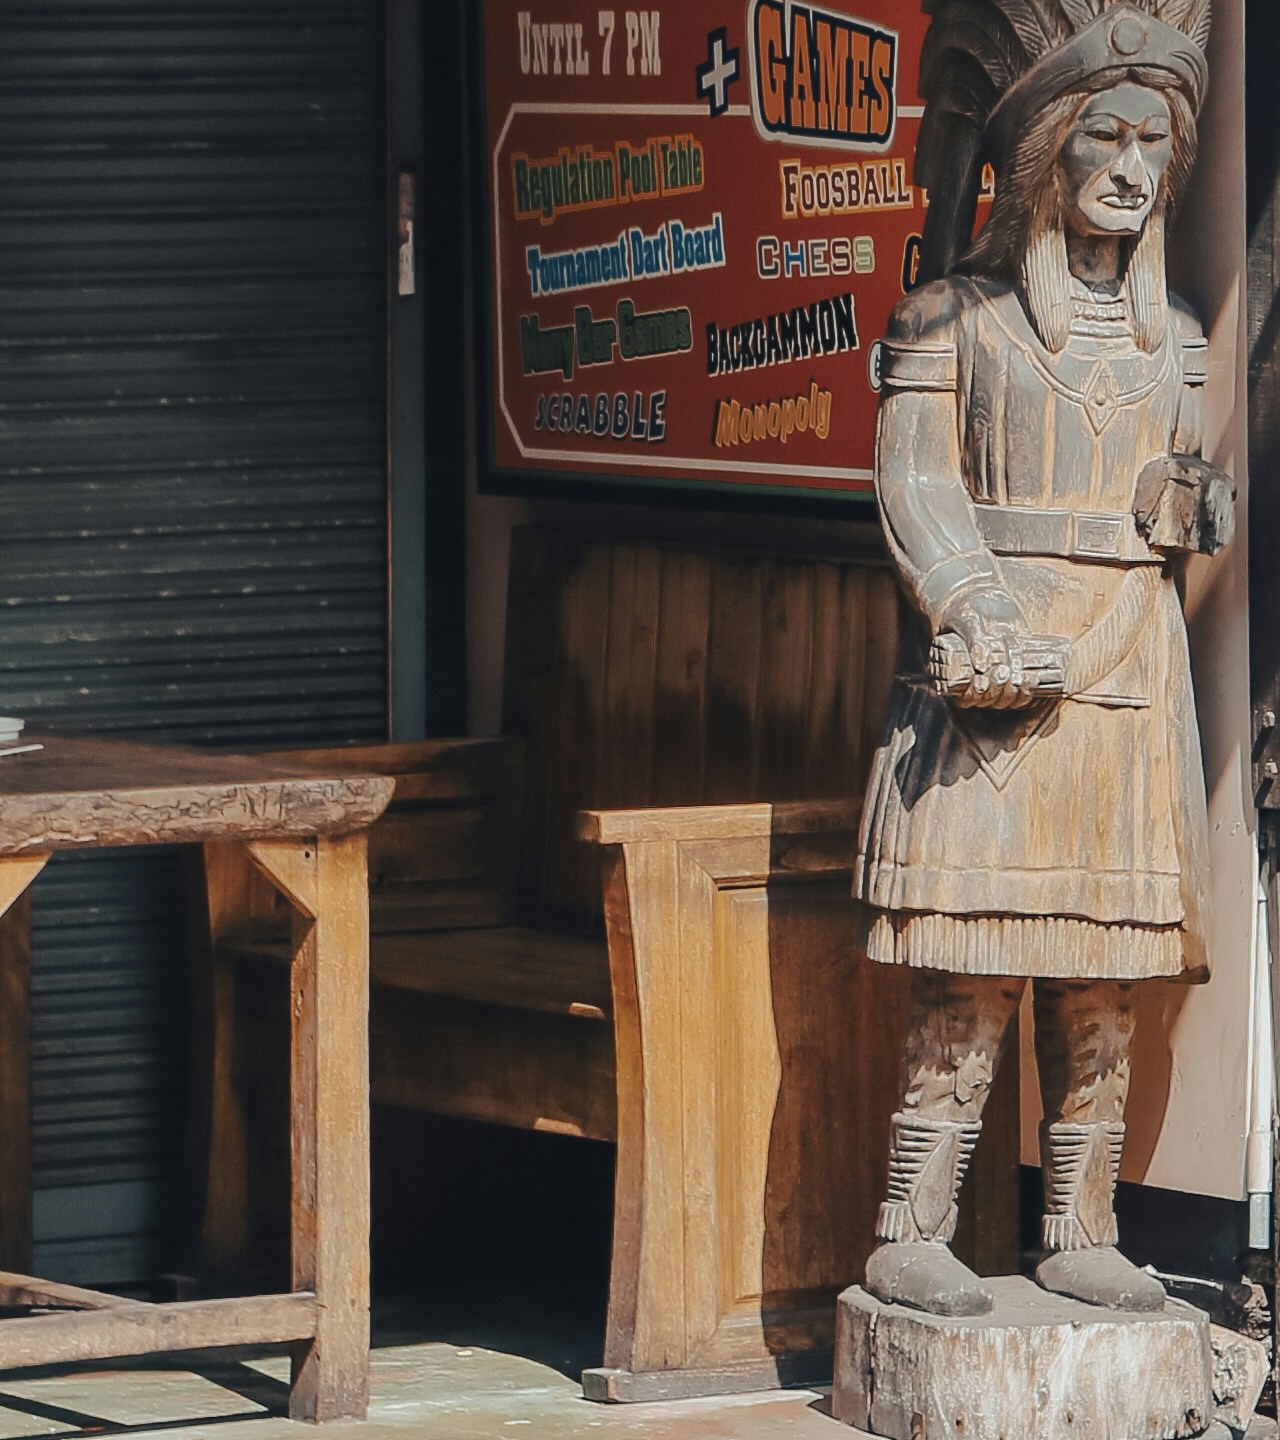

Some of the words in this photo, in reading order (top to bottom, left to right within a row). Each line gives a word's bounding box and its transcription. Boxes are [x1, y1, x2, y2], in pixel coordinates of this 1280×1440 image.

[517, 11, 589, 77] UNTIL
[599, 11, 614, 76] 7
[626, 11, 662, 77] PM
[513, 146, 616, 224] Regulation
[615, 139, 659, 203] Pool
[659, 134, 704, 197] Table
[780, 160, 913, 217] FOOSBALL
[526, 229, 629, 297] Tournament
[629, 223, 670, 281] Dart
[669, 212, 726, 274] Board
[756, 235, 876, 280] CHESS
[575, 305, 616, 367] Bar
[617, 299, 692, 360] Games
[536, 390, 666, 442] SCRABBLE
[715, 381, 832, 448] Monopoly
